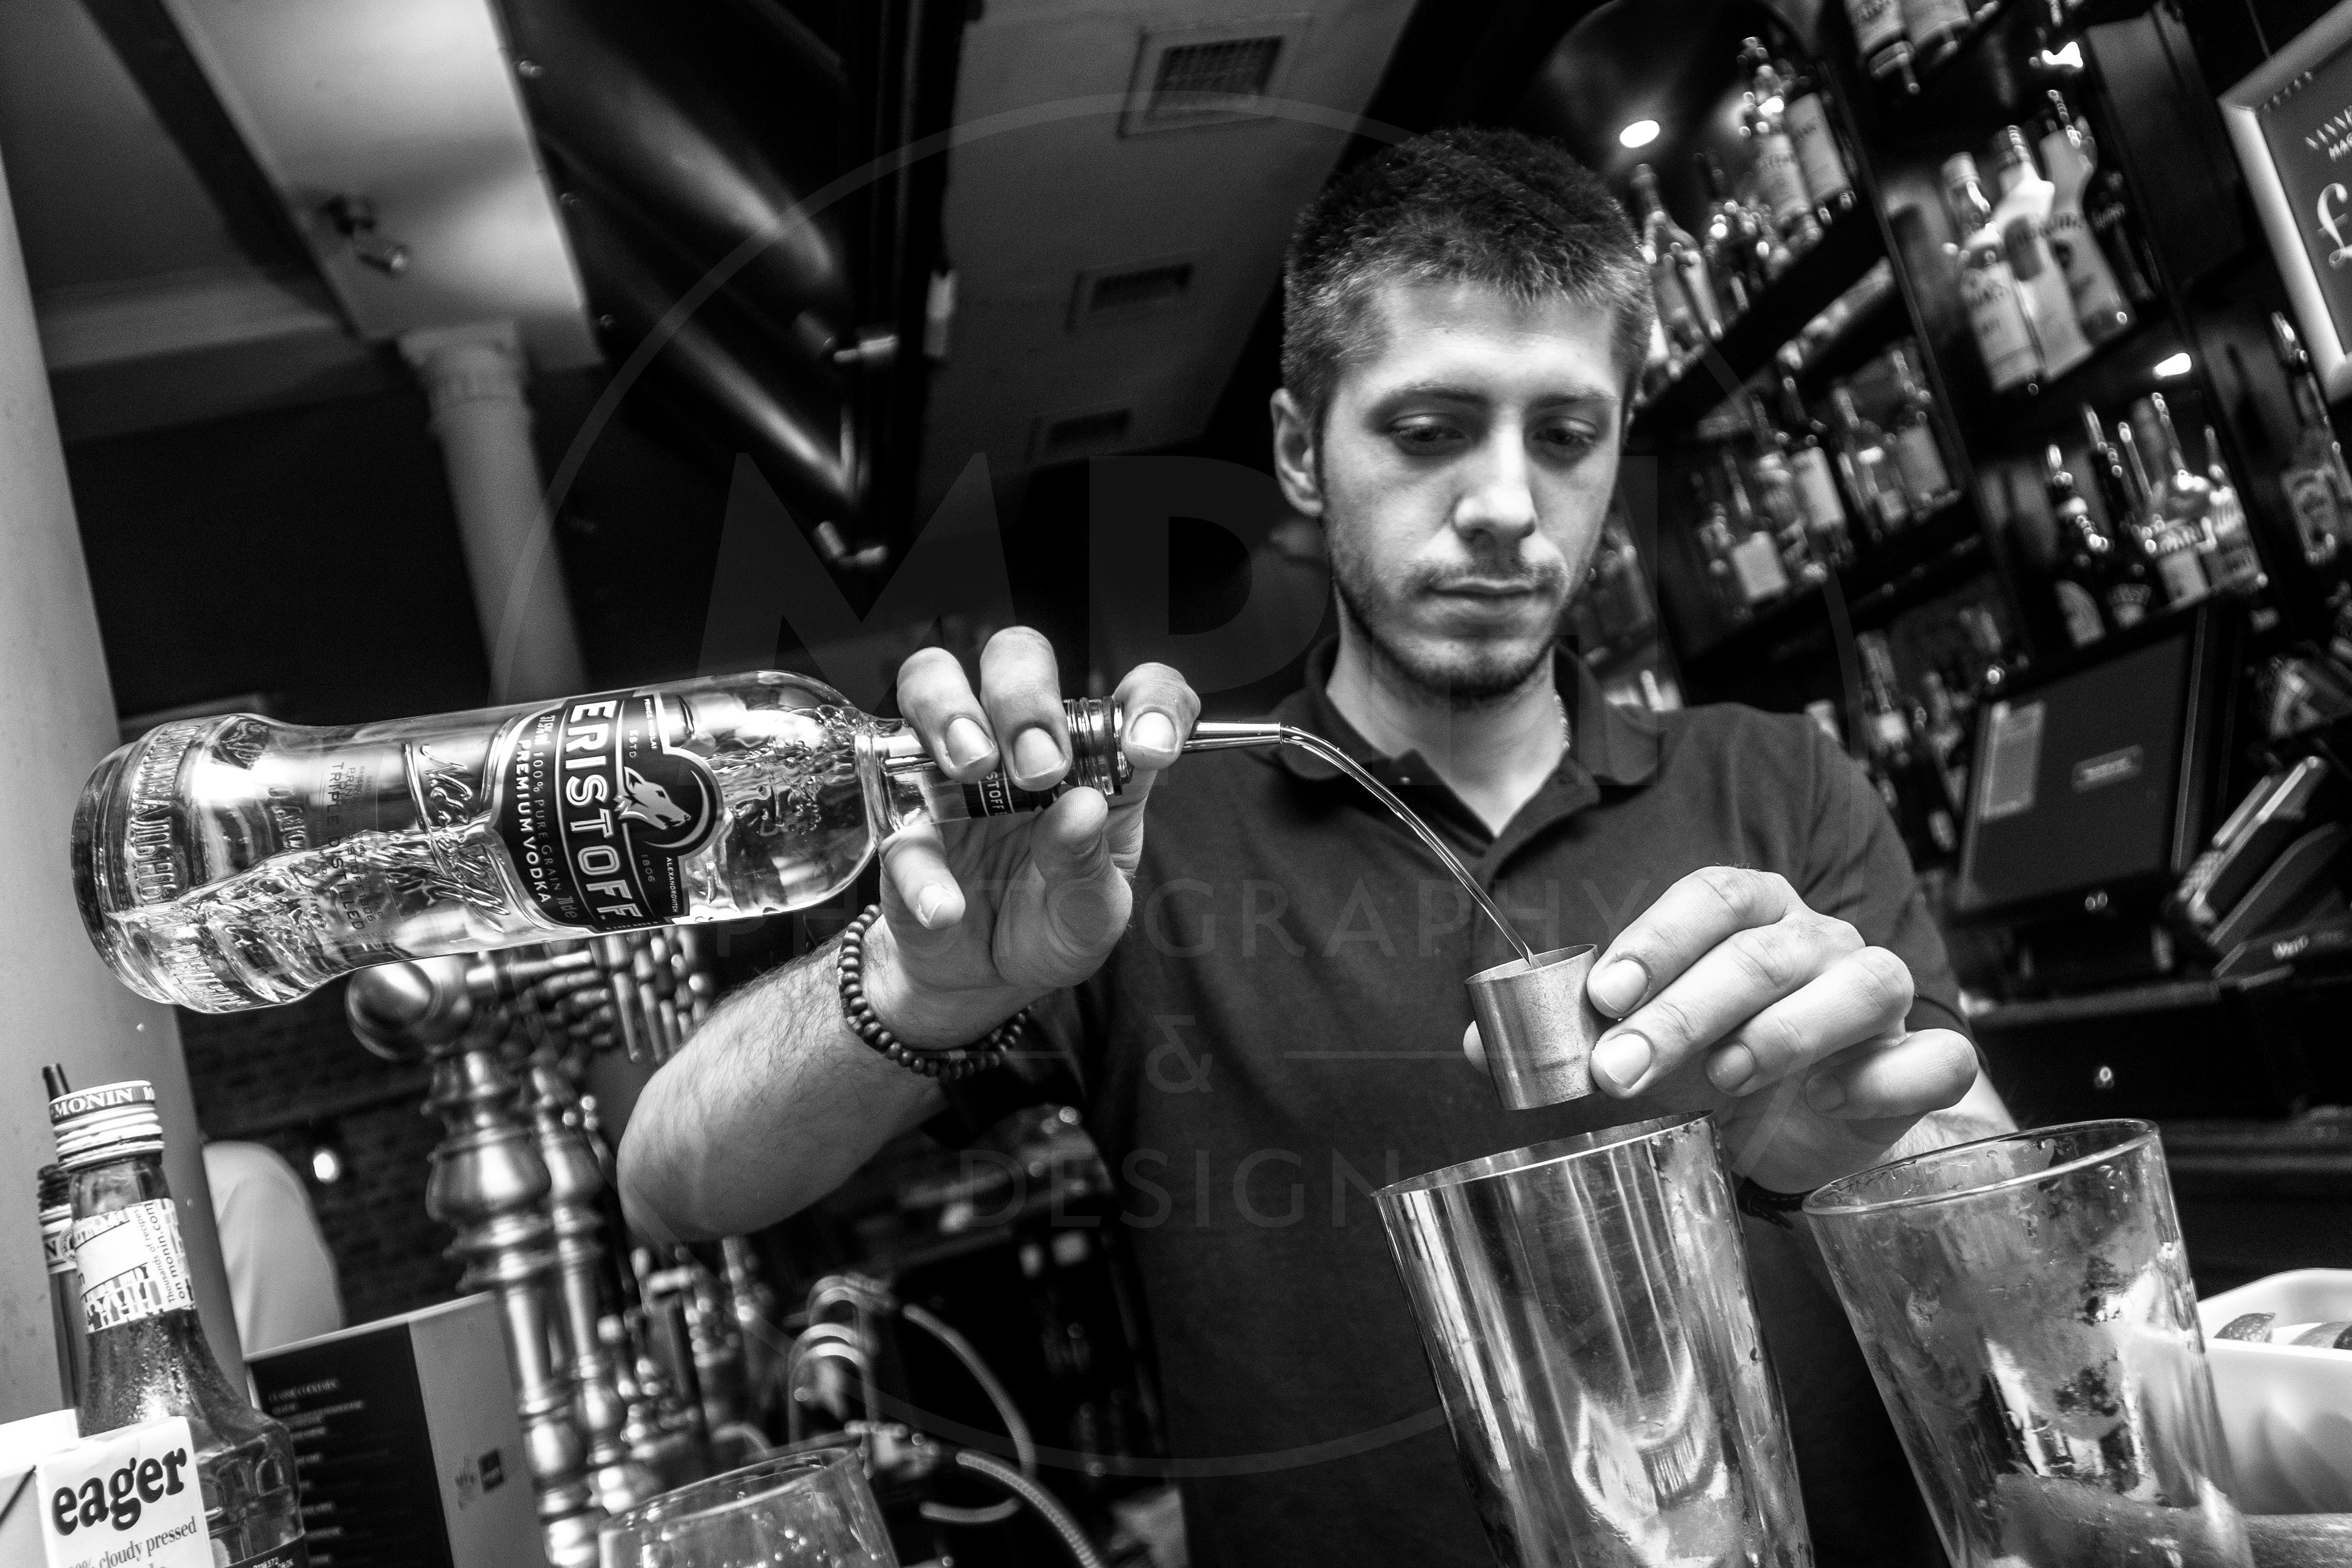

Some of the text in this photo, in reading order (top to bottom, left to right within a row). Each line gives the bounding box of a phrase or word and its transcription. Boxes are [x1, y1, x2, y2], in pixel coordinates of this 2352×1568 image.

[532, 752, 545, 793] 100%
[986, 771, 1005, 809] STOFF
[516, 739, 551, 903] PREMIUM VODKA
[534, 799, 548, 839] PURE
[565, 699, 643, 919] ERISTOFF
[628, 729, 656, 883] ESTD 1806
[327, 761, 365, 930] TRIPLE DISTILLED
[541, 843, 562, 890] GRAIN
[54, 1087, 134, 1118] MONIN
[134, 1208, 151, 1243] recipes
[145, 1243, 156, 1253] of
[144, 1202, 186, 1300] on monin.com
[51, 1447, 187, 1536] eager
[99, 1515, 197, 1568] cloudy pressed
